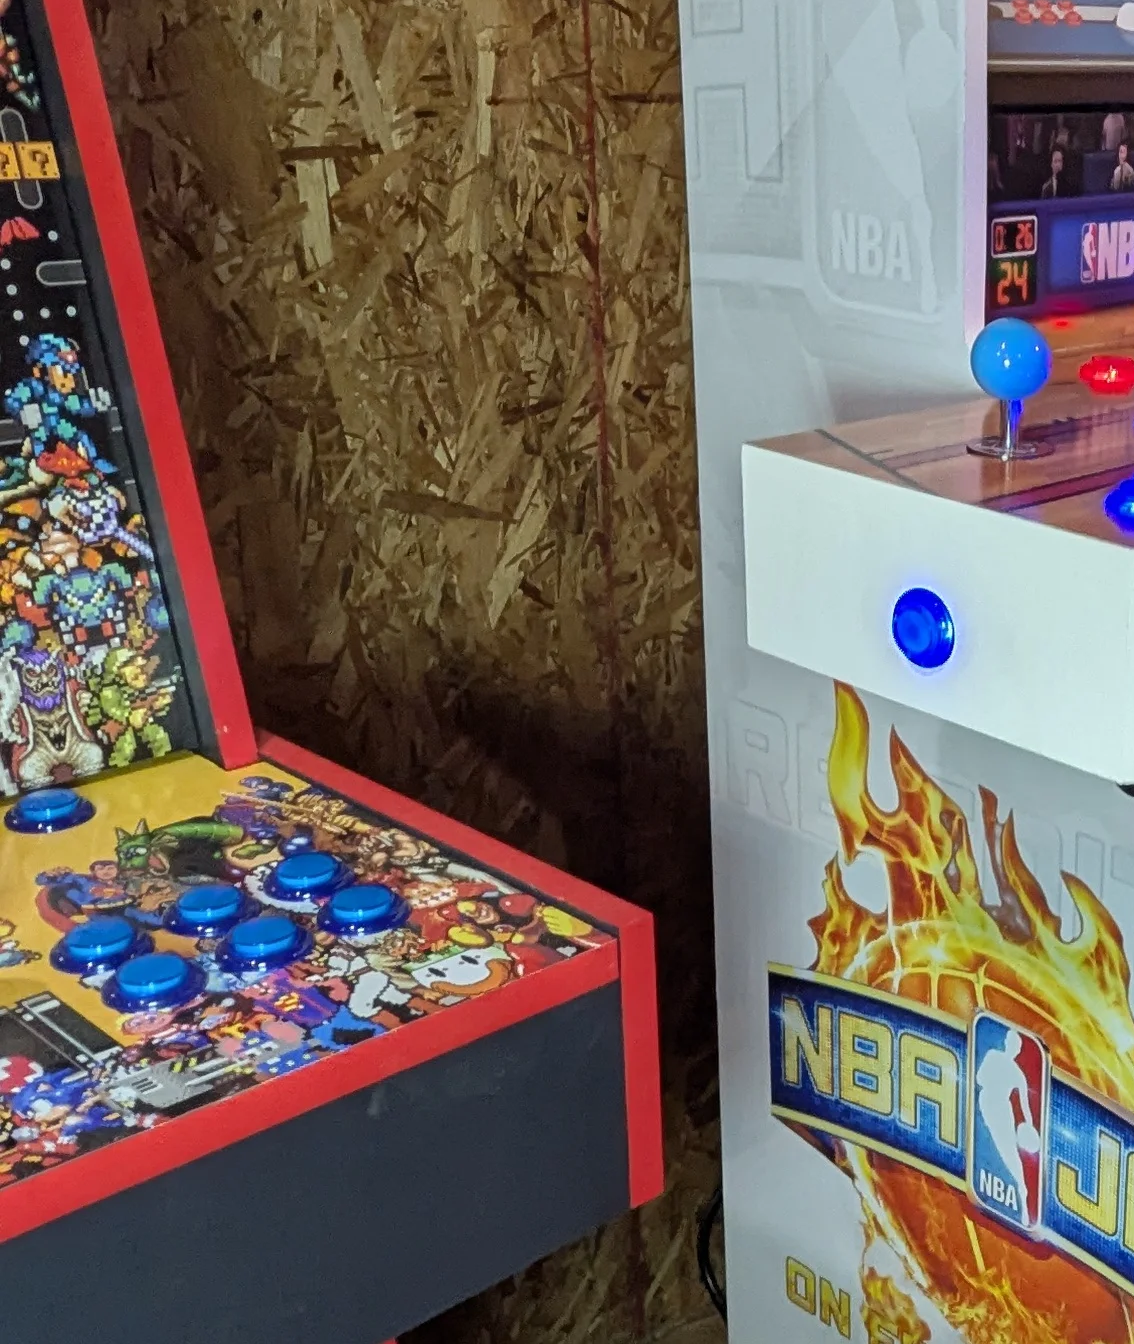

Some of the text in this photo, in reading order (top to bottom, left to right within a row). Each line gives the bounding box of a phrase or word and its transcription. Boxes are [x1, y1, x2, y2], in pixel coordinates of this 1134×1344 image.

[830, 209, 912, 282] NBA
[996, 260, 1030, 305] 24
[780, 996, 961, 1149] NBA
[977, 1167, 1018, 1213] NBA
[785, 1254, 852, 1338] ON
